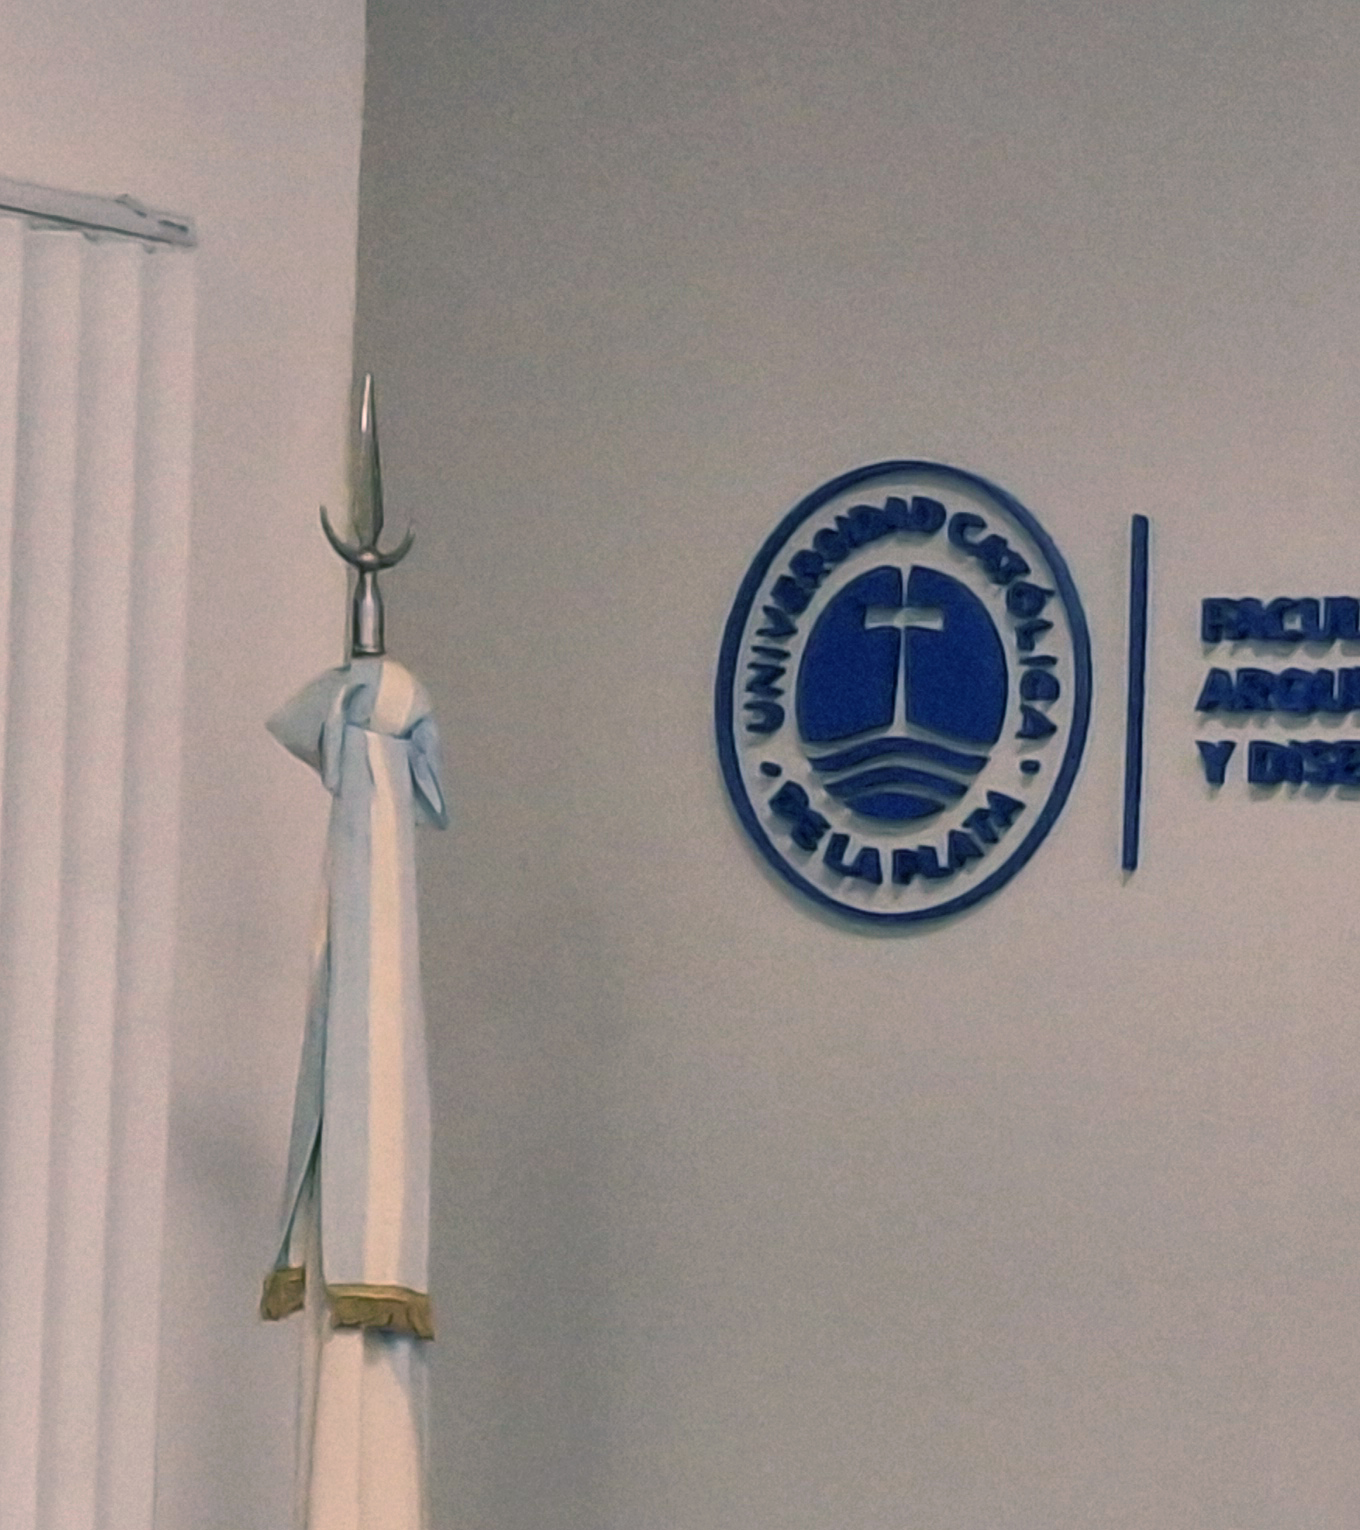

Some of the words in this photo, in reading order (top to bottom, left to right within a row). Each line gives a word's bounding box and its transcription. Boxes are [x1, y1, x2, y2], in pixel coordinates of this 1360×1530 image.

[1195, 740, 1237, 785] Y
[768, 780, 832, 852] DE
[822, 832, 883, 885] LA
[891, 789, 1026, 885] PLATA
